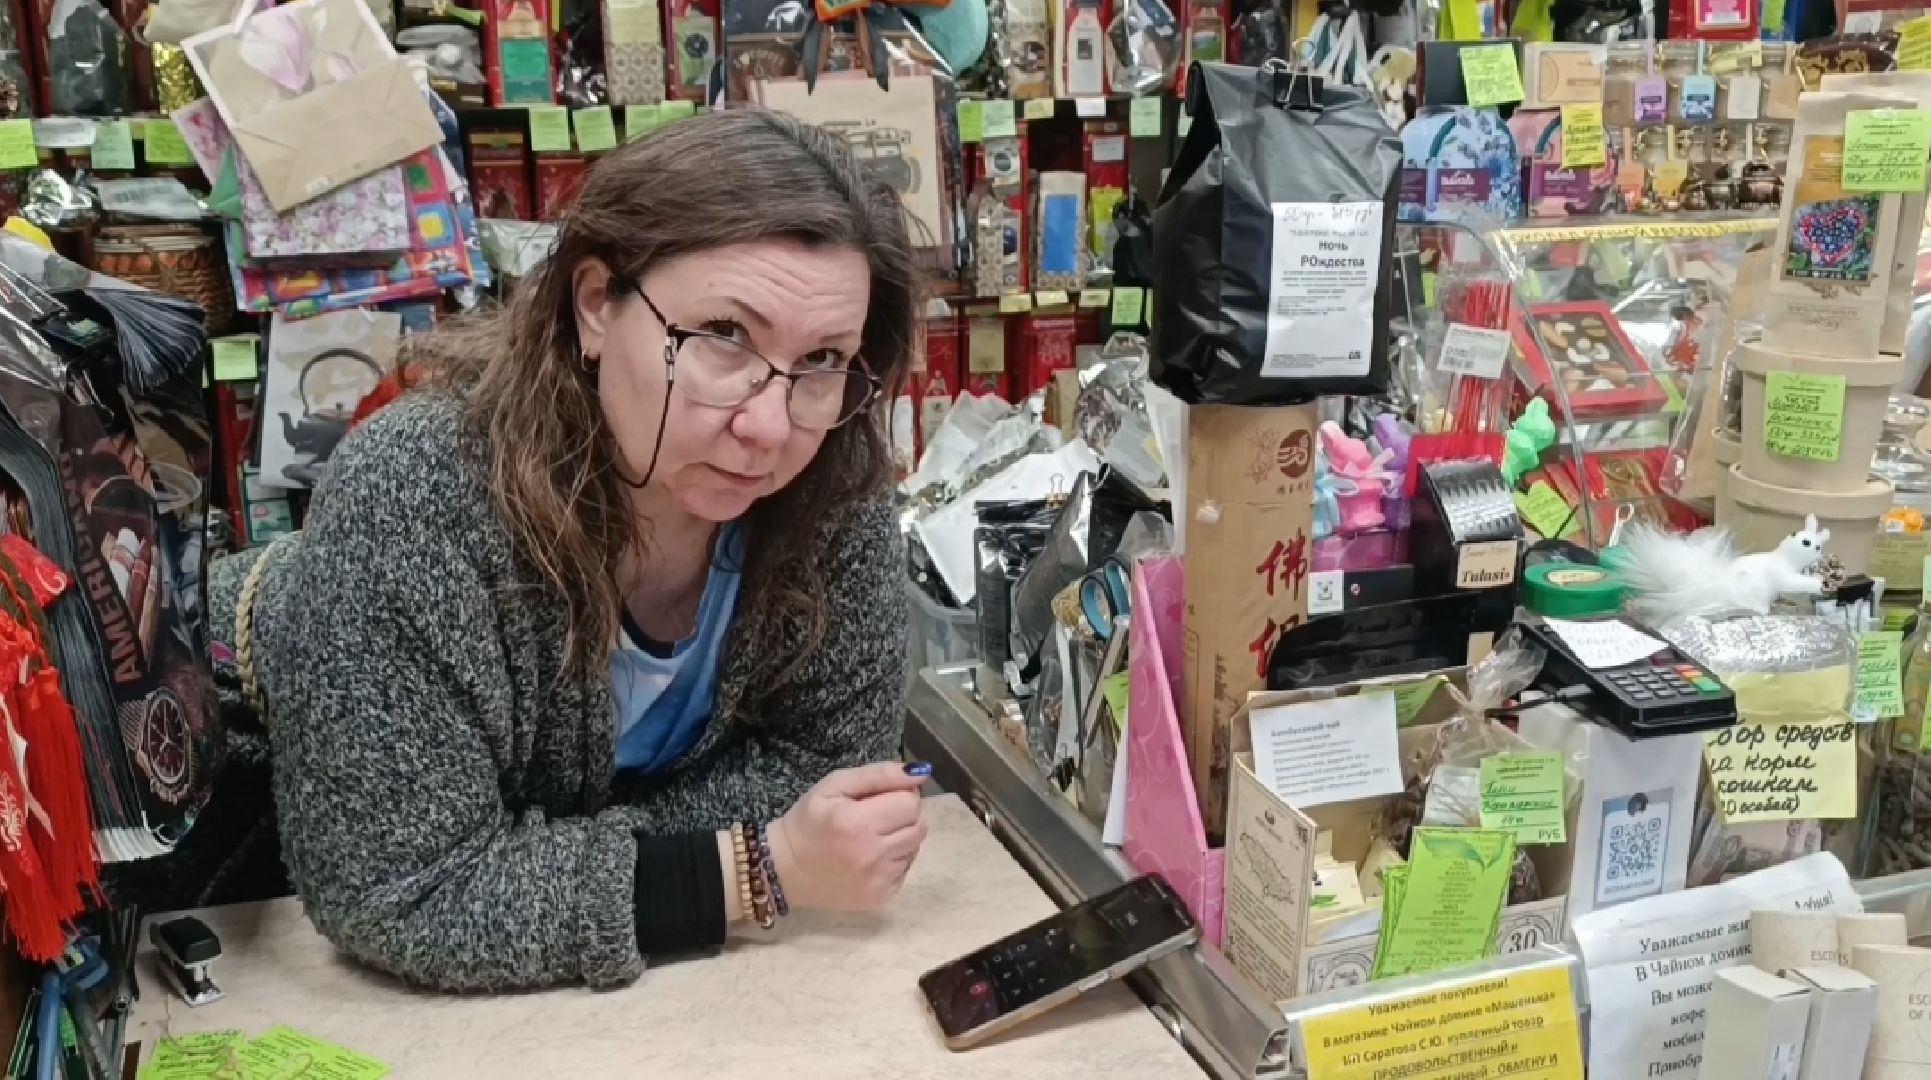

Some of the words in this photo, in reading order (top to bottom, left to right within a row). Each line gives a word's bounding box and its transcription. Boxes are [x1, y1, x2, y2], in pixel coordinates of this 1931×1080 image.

[1319, 241, 1348, 251] Ночь
[1301, 254, 1365, 268] РОждества
[1462, 567, 1504, 583] Tulasi
[1708, 722, 1765, 750] бор
[1775, 722, 1855, 750] средств
[1538, 829, 1561, 840] РУБ
[1640, 926, 1724, 954] Уважаемые
[1635, 965, 1648, 981] В
[1650, 954, 1706, 977] Чайном
[1368, 994, 1437, 1016] Уважаемые
[1440, 978, 1508, 1000] покупатели!
[1651, 988, 1673, 1006] Вы
[1909, 994, 1931, 1005] ESC
[1323, 1037, 1331, 1048] В
[1333, 1027, 1388, 1047] магазине
[1391, 1017, 1436, 1034] Чайном
[1439, 1007, 1482, 1026] домике
[1485, 992, 1556, 1013] «Машенька»
[1363, 1044, 1417, 1063] Саратова
[1447, 1020, 1510, 1046] купленный
[1512, 1015, 1544, 1030] товар
[1498, 1056, 1547, 1074] ОБМЕНУ
